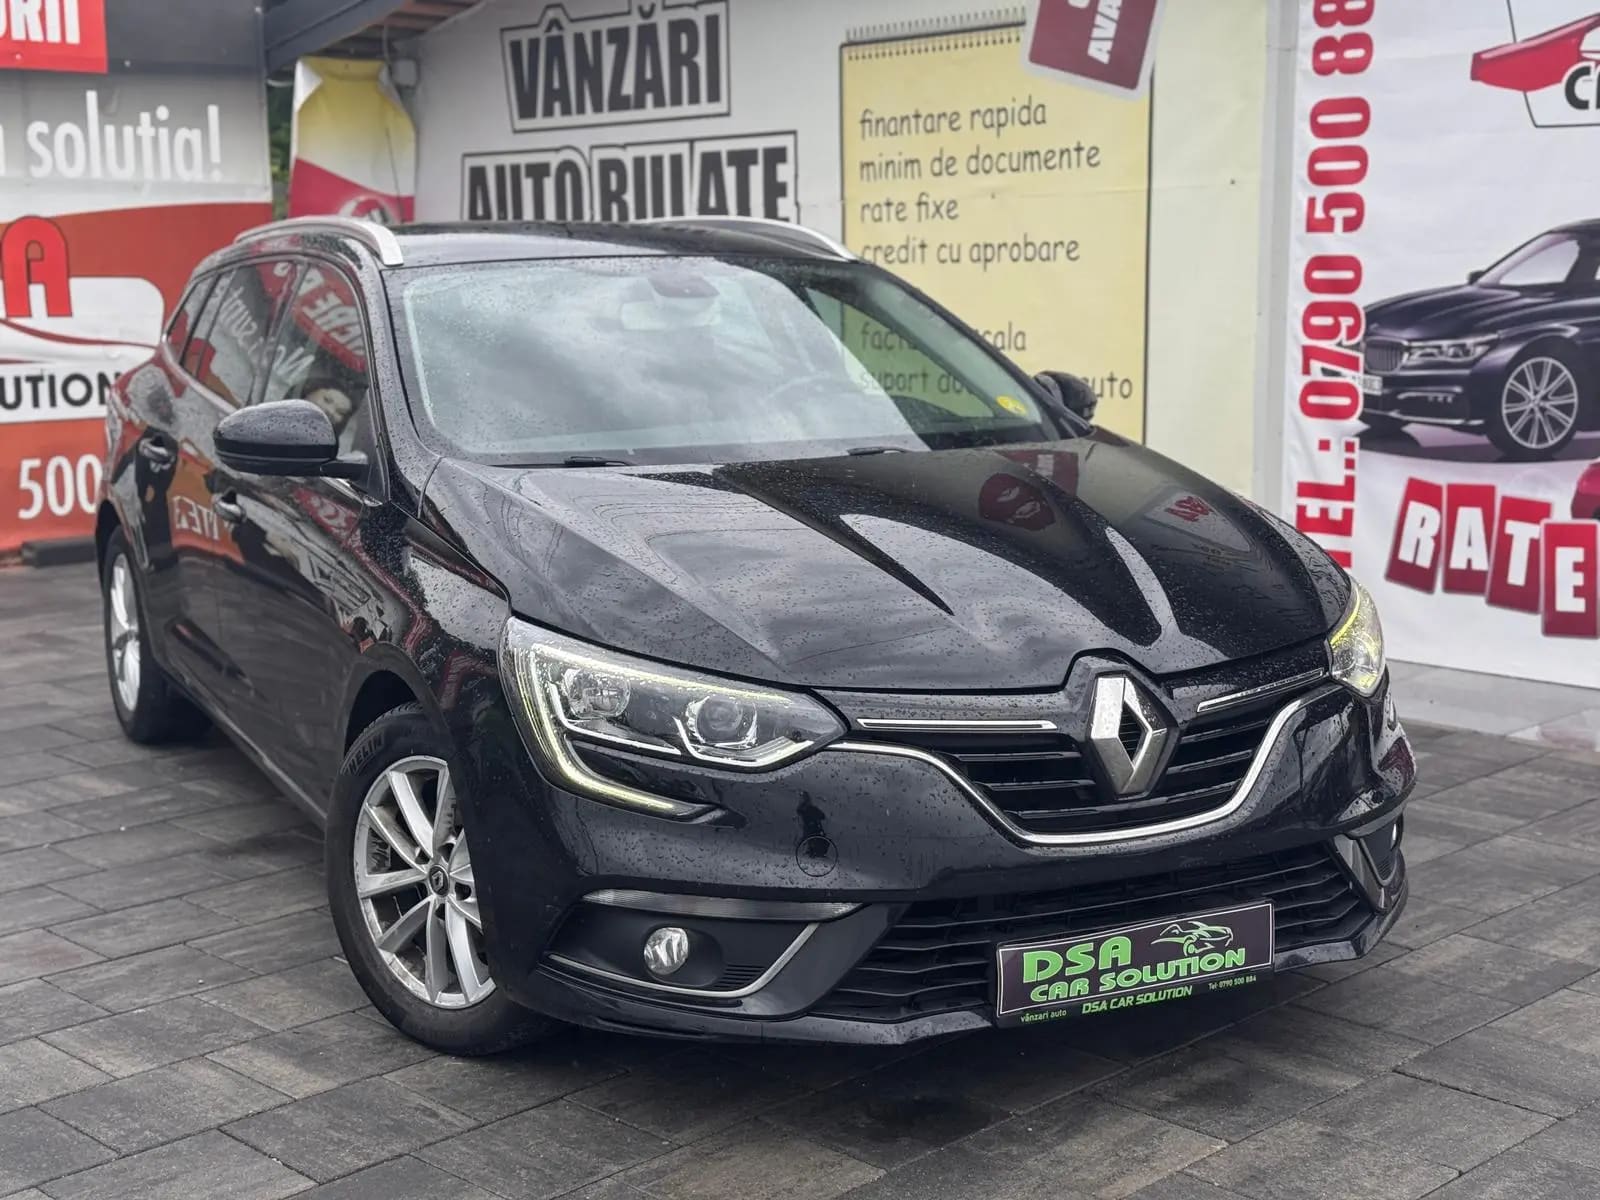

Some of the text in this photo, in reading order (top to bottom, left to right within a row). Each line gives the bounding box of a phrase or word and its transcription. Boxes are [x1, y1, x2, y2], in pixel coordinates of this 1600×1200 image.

[27, 90, 222, 182] solutia!
[859, 94, 1047, 141] finantare rapida
[859, 140, 1101, 182] minim de documente
[1306, 95, 1371, 234] 500
[860, 192, 959, 223] rate fixe
[860, 233, 1081, 271] credit cu aprobare
[1299, 254, 1364, 420] 0790
[1022, 935, 1132, 983] DSA
[1030, 947, 1246, 1002] CAR SOLUTION
[1234, 976, 1245, 986] 500
[1051, 1009, 1067, 1020] auto
[1081, 984, 1193, 1014] DSA CAR SOLUTION
